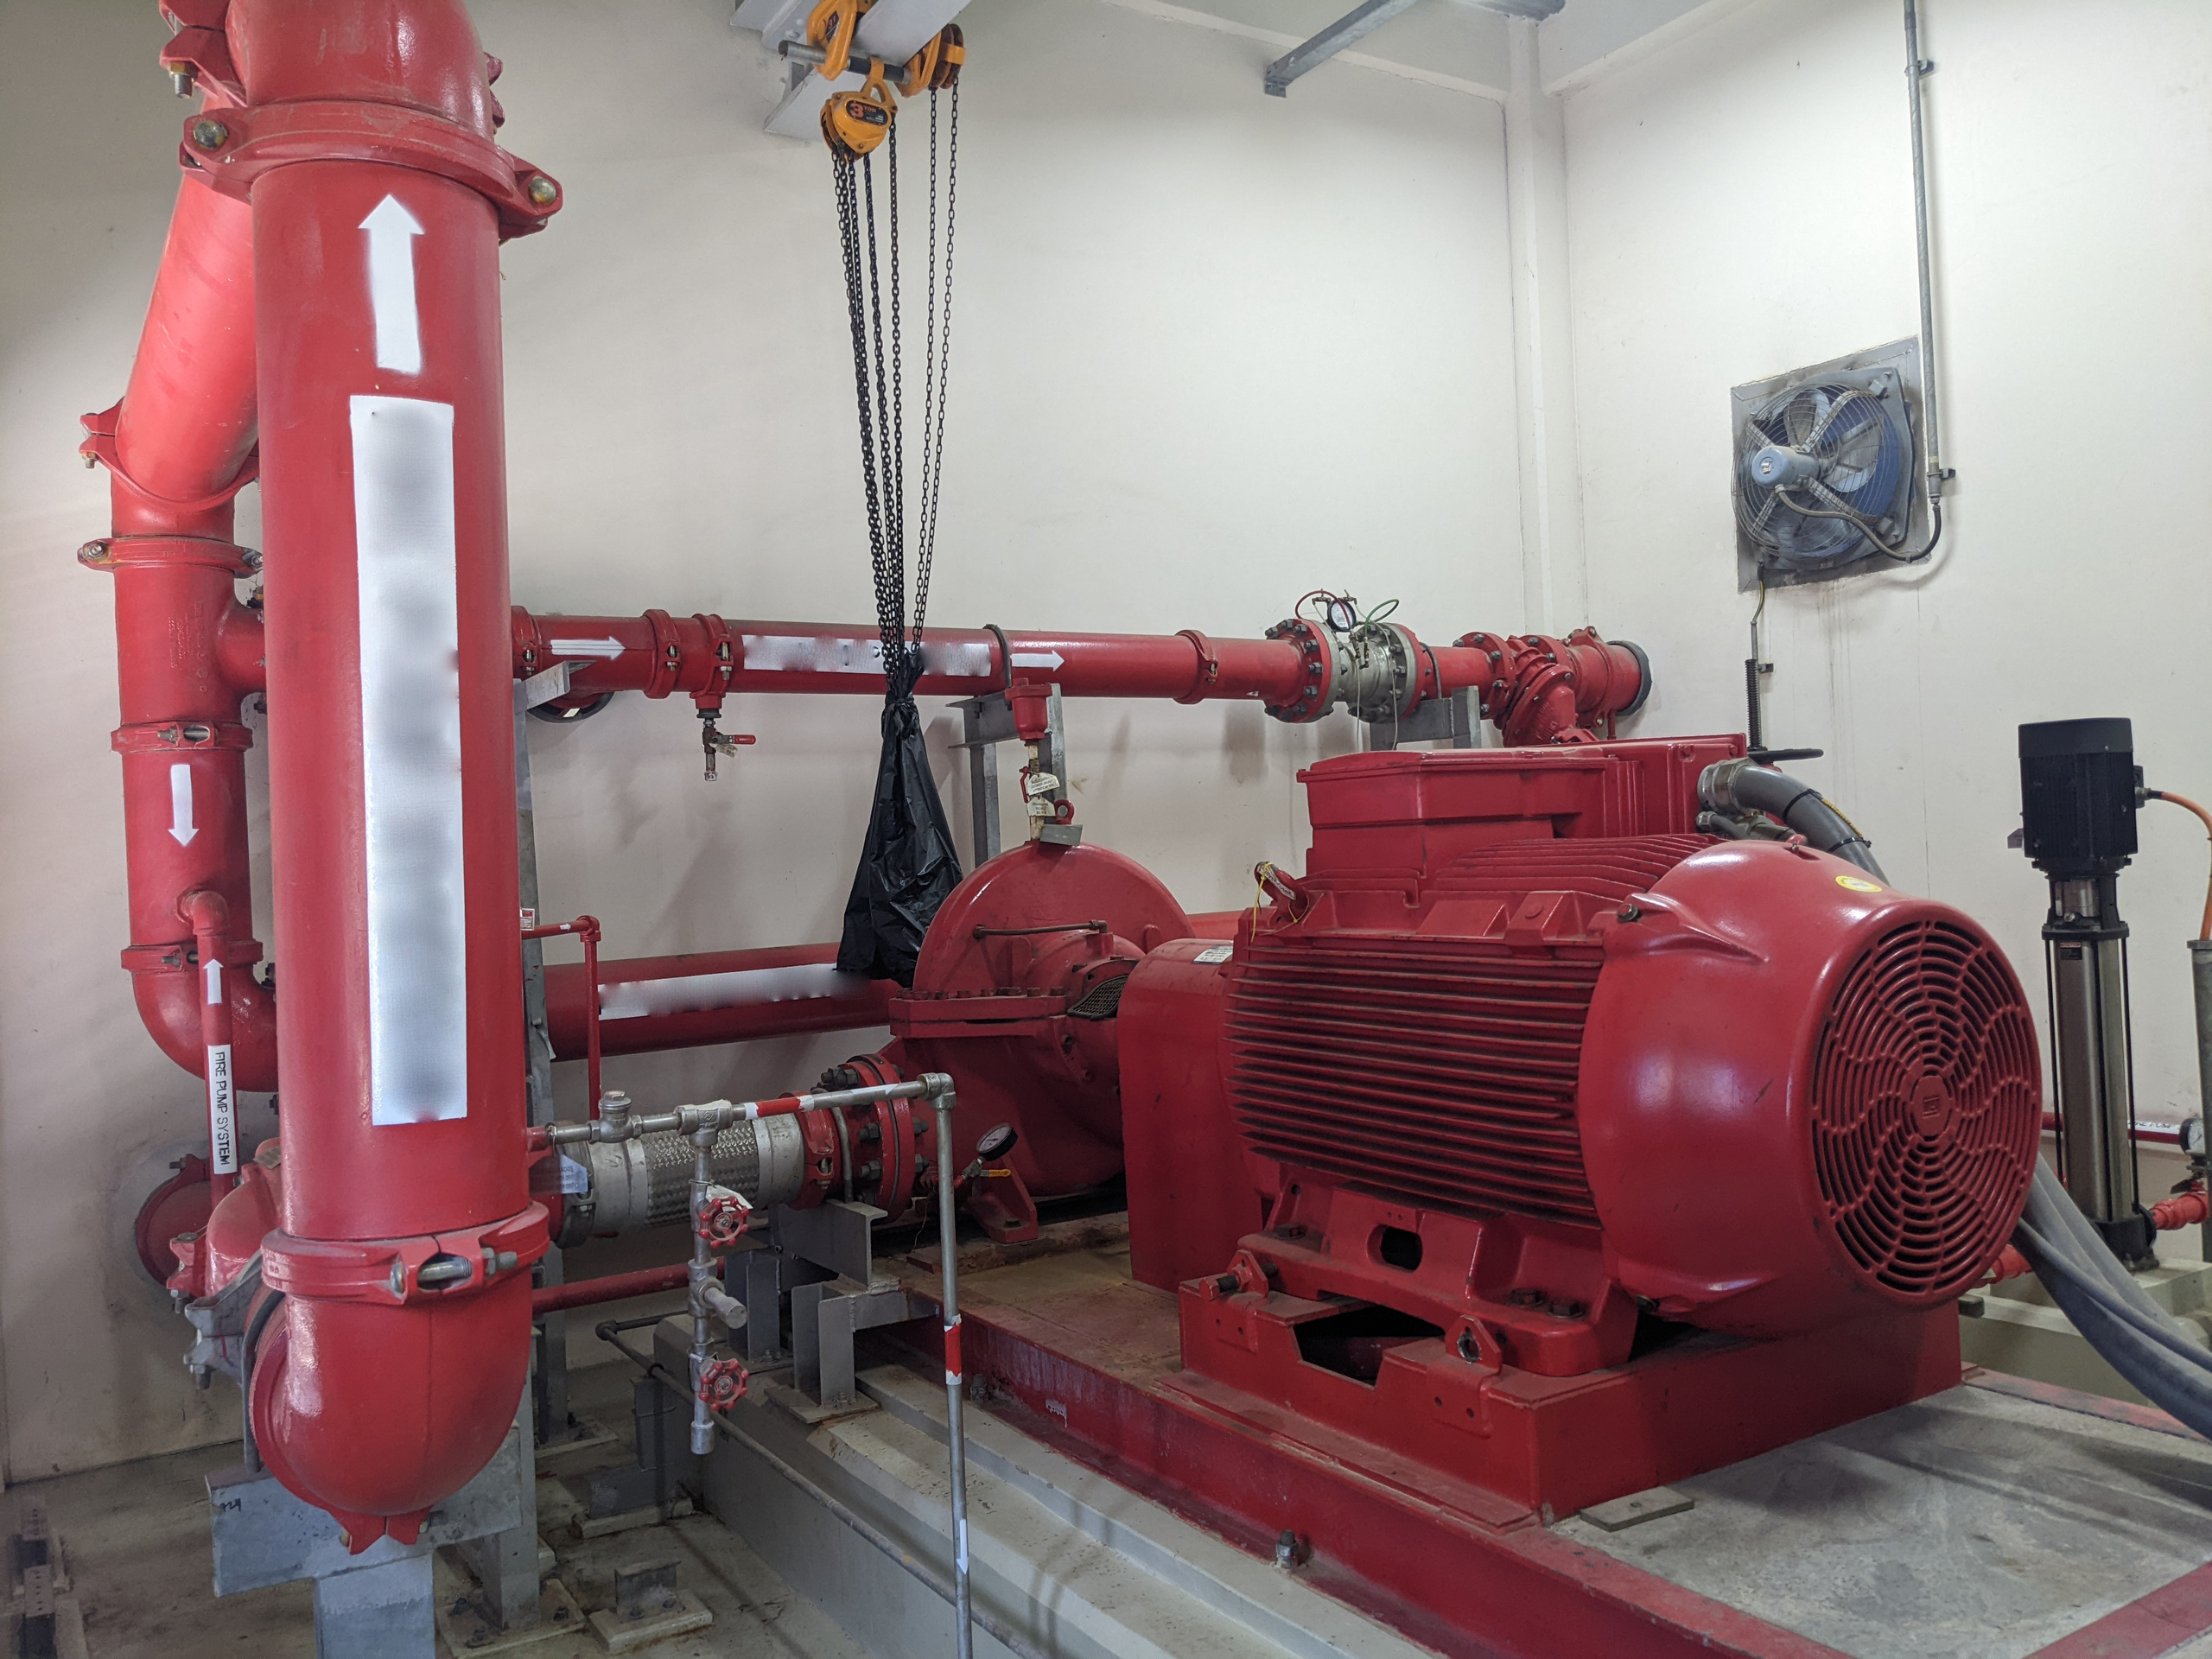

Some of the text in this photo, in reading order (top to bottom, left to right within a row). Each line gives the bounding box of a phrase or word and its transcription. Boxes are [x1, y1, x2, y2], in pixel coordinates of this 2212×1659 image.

[849, 103, 863, 118] 3
[215, 1052, 231, 1165] FIRE PUMP SYSTEM
